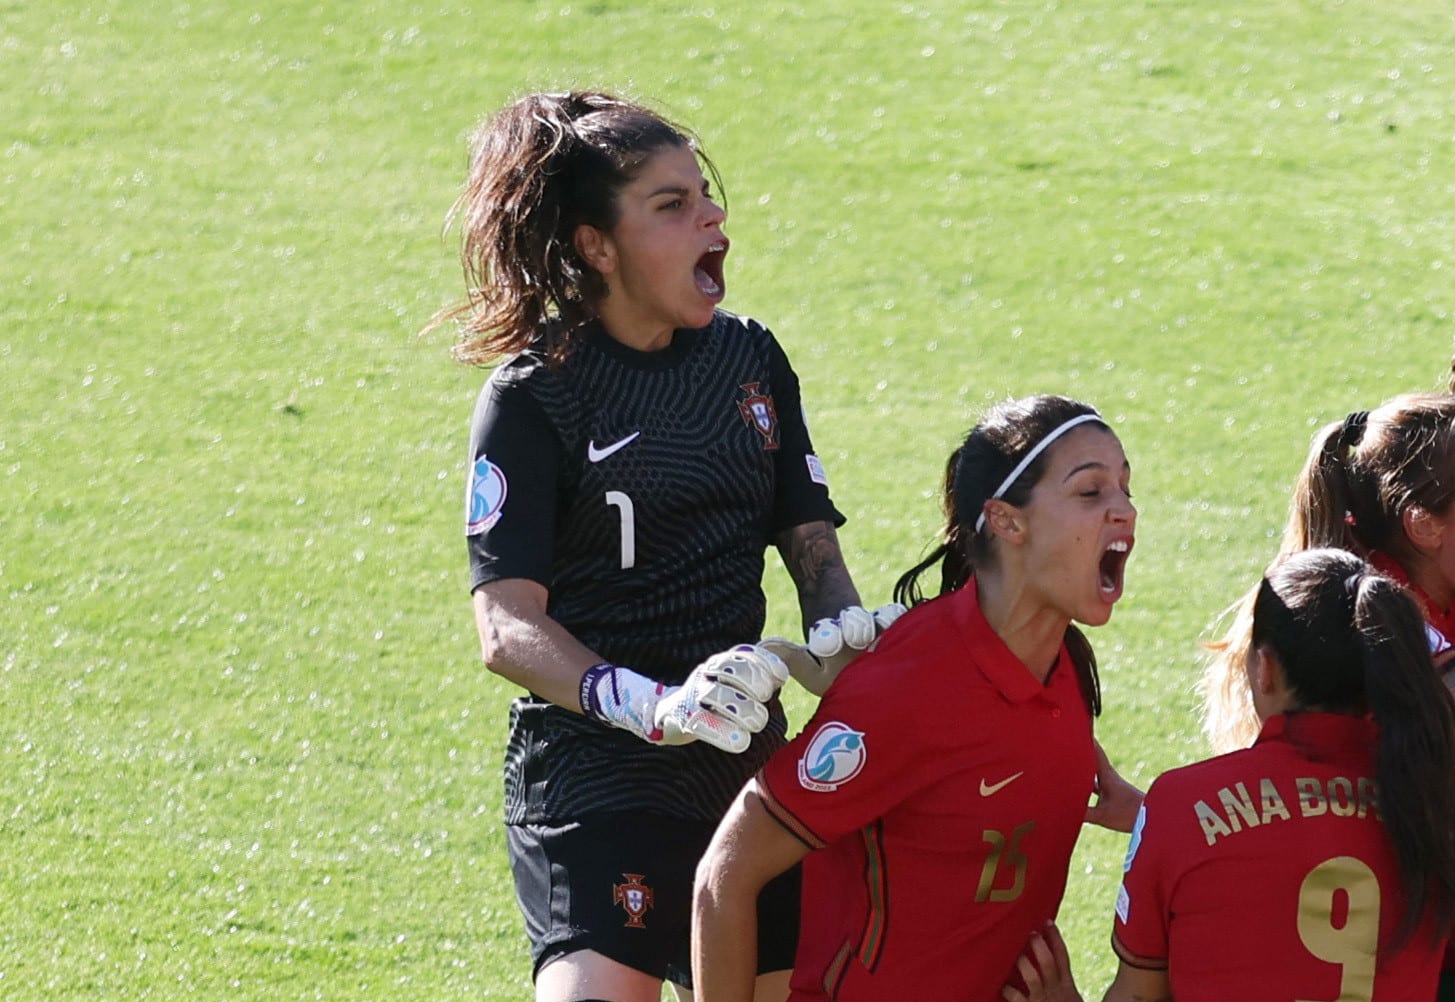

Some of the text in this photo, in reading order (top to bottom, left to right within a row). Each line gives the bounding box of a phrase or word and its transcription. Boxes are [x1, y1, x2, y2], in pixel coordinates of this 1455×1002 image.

[606, 490, 636, 570] 1
[1193, 776, 1388, 846] ANA BOR
[974, 818, 1036, 902] 15
